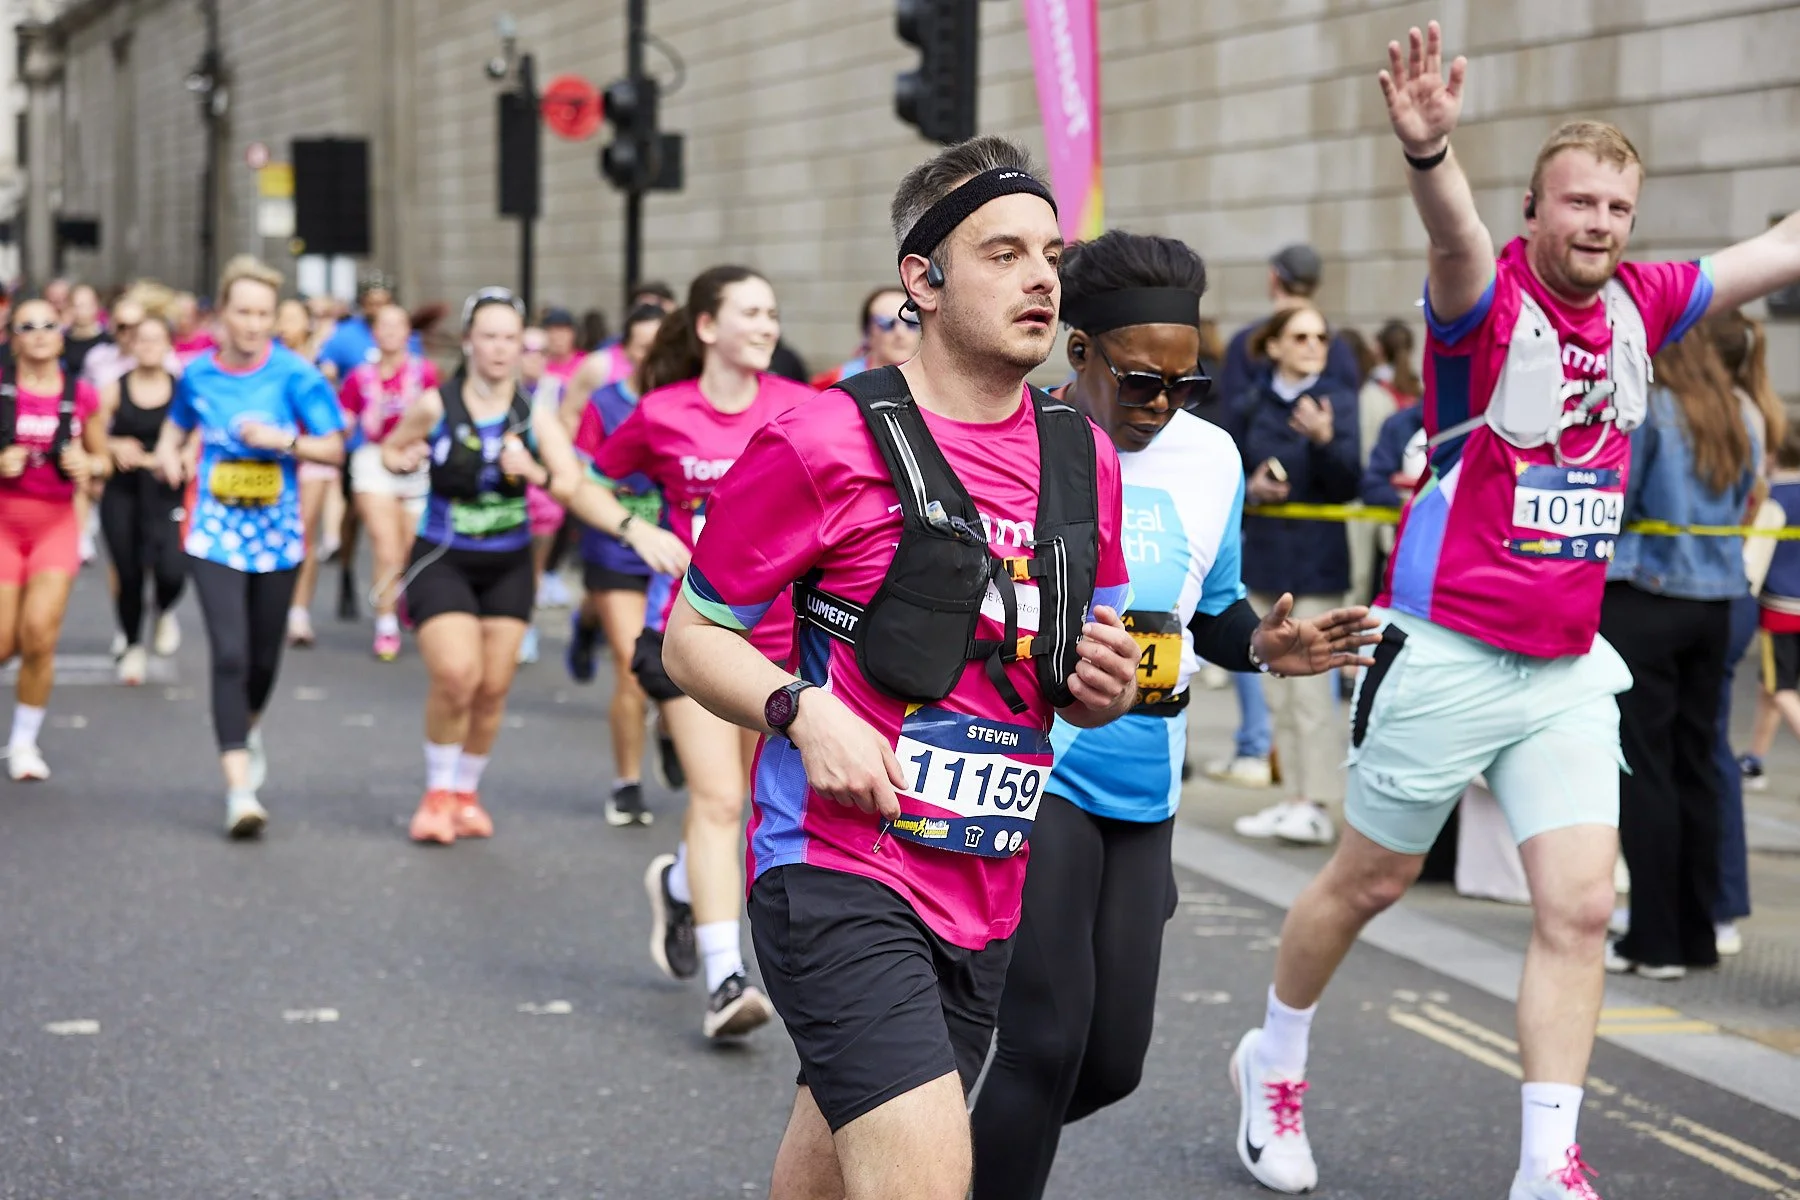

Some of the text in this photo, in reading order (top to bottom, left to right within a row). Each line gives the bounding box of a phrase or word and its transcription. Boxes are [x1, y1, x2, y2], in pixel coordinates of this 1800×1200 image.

[1527, 495, 1617, 527] 10104
[807, 593, 859, 632] LUMEFIT
[966, 725, 1019, 747] STEVEN
[910, 749, 1041, 812] 11159
[893, 818, 919, 832] LONDON
